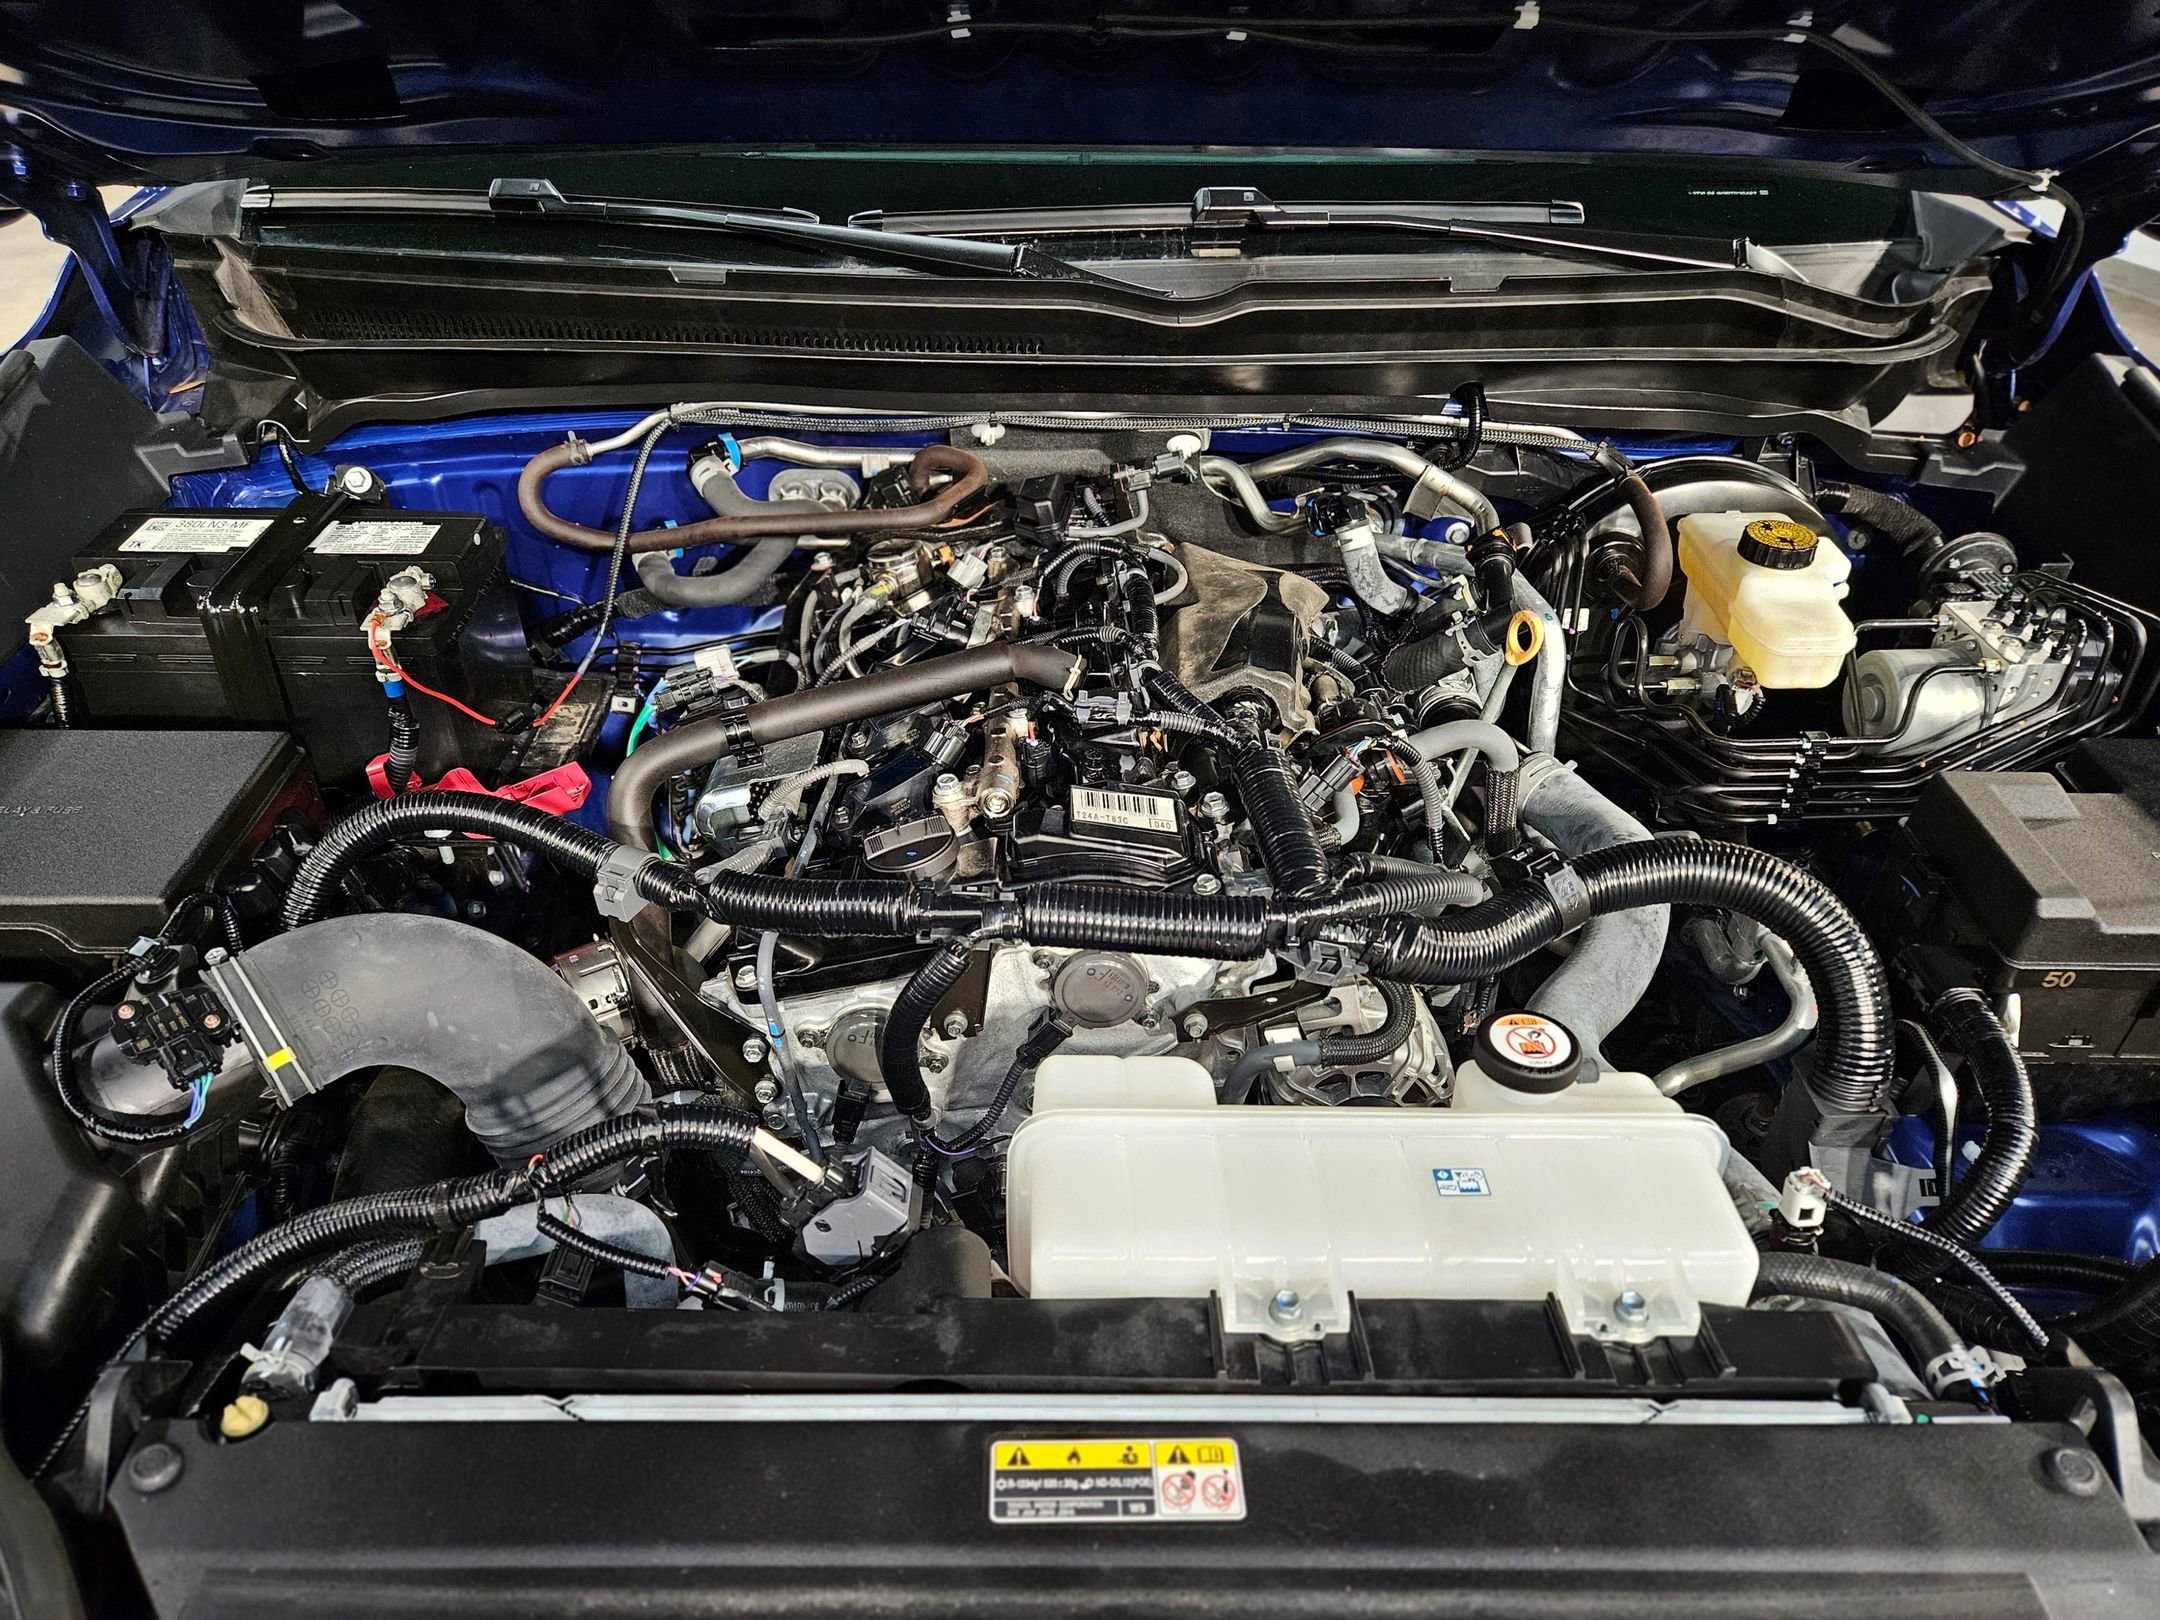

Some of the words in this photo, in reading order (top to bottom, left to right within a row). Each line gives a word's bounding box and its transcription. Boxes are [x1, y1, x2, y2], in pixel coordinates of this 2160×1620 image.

[0, 805, 32, 815] ELAY
[44, 805, 83, 815] FUSE
[2041, 971, 2076, 988] 50
